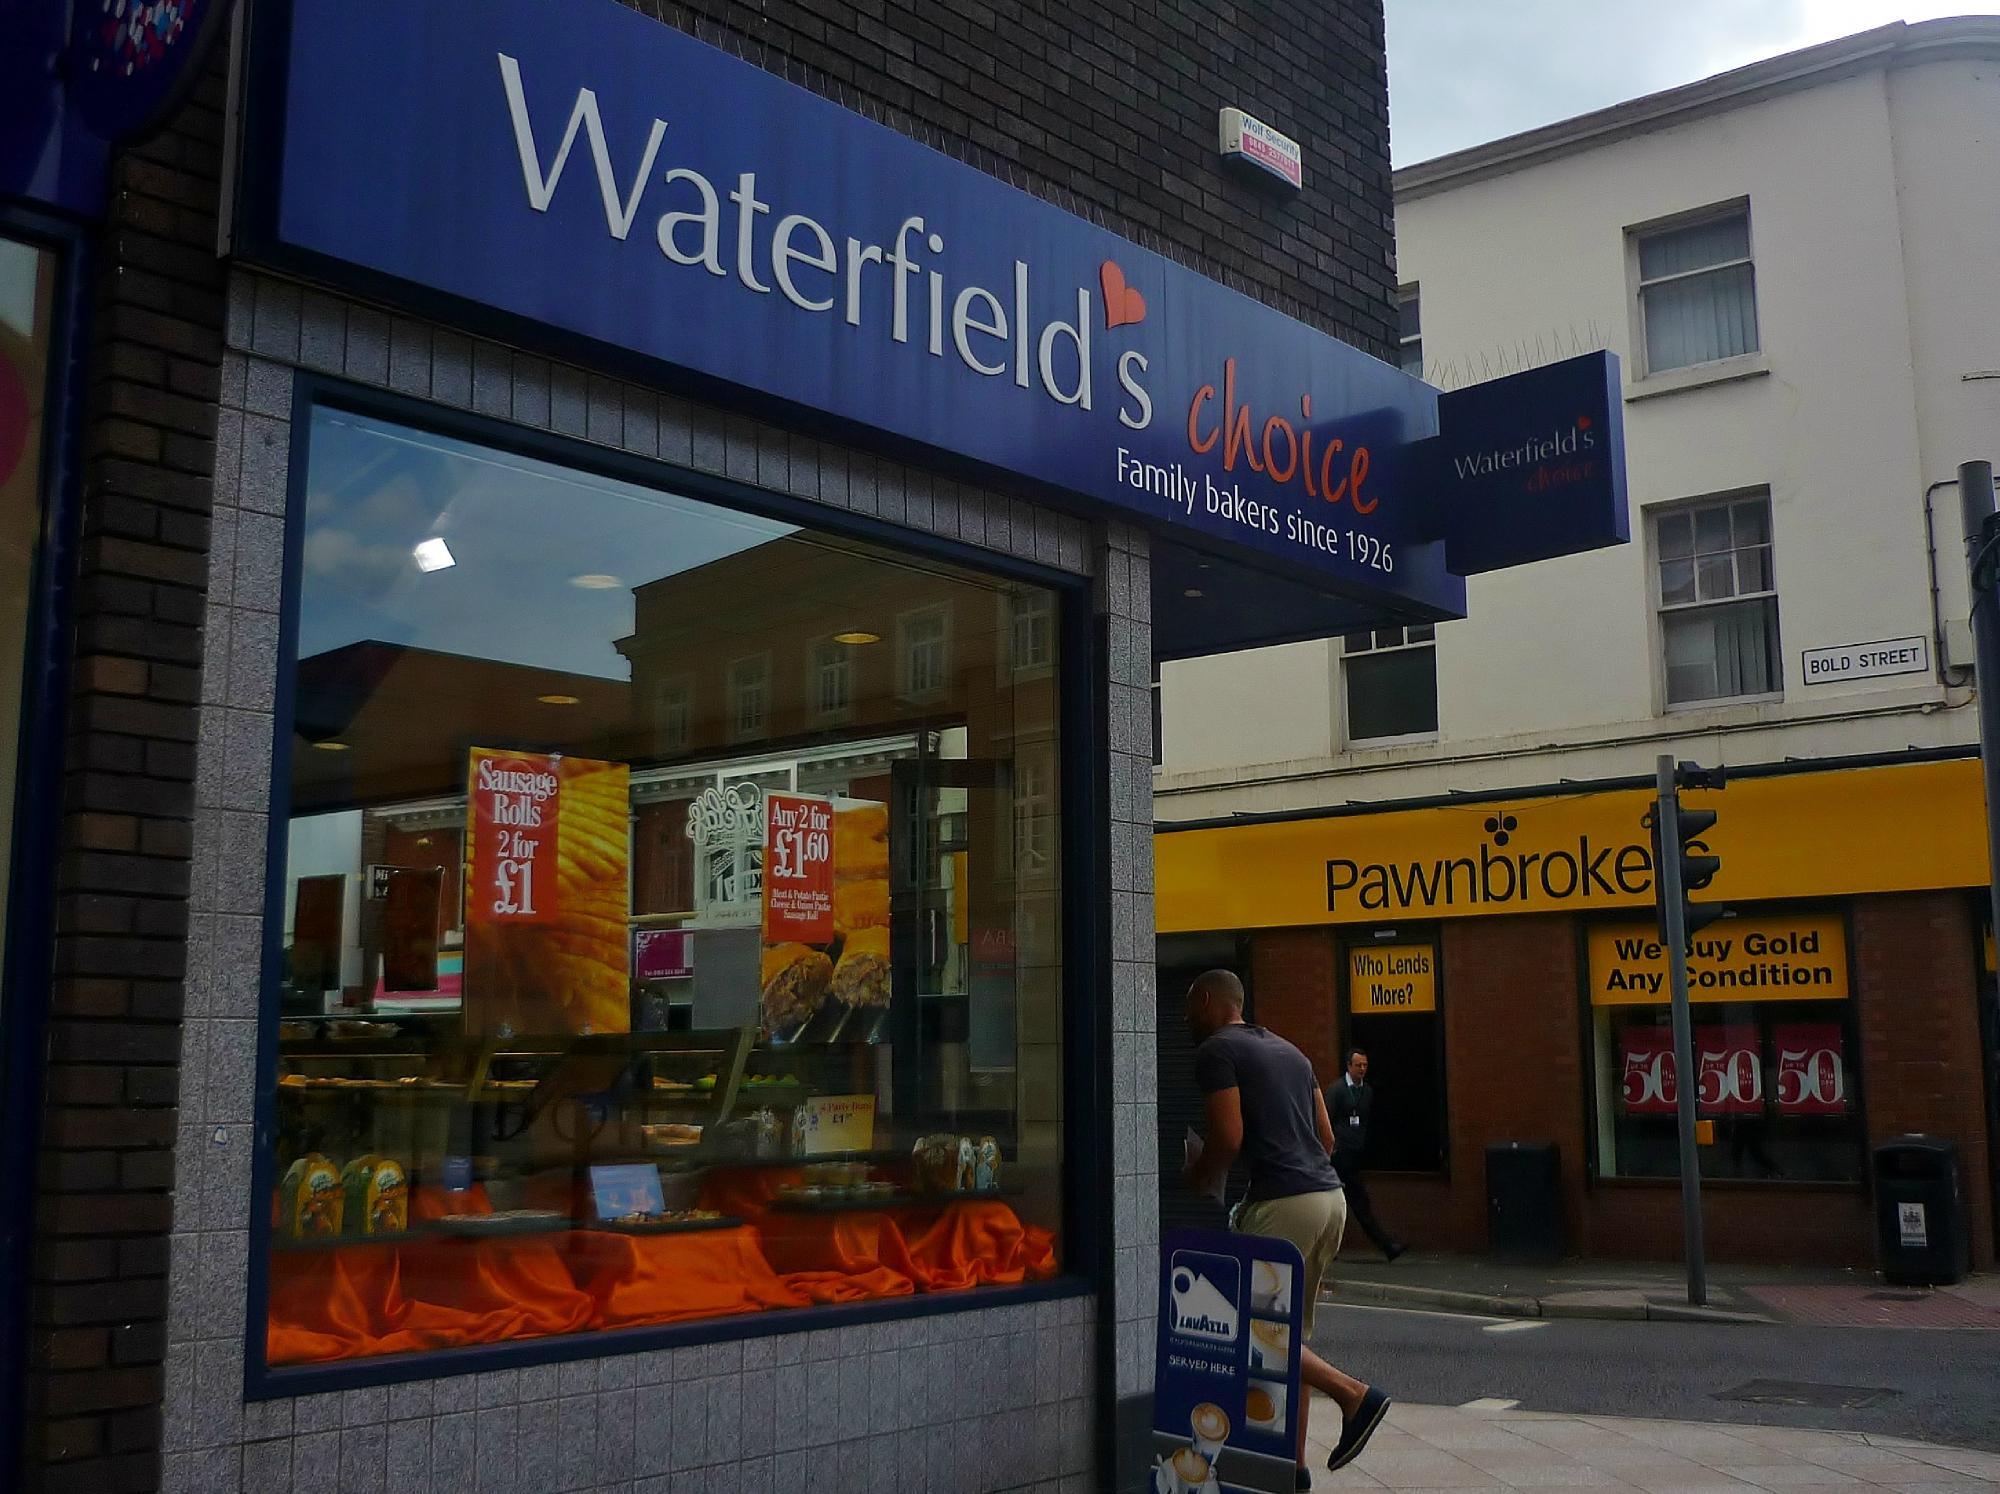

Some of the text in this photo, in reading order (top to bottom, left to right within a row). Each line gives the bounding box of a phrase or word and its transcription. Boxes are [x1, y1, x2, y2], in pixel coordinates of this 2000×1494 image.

[1187, 356, 1378, 515] choice
[1117, 447, 1393, 573] Family bakers since 1926
[1810, 647, 1919, 674] BOLD STREET
[479, 759, 558, 801] Sausage
[492, 793, 542, 827] Rolls
[770, 800, 831, 833] Any 2 for
[497, 829, 539, 859] 2 for
[773, 829, 830, 879] £1.60
[494, 860, 537, 915] £1
[1327, 835, 1713, 912] Pawnbrokes
[1615, 939, 1662, 960] We
[1743, 931, 1819, 956] Gold
[1353, 951, 1429, 976] Who Lends
[1370, 982, 1413, 1006] More?
[1606, 968, 1664, 994] Any
[1698, 1050, 1762, 1104] 50
[1778, 1049, 1844, 1104] 50
[1179, 1314, 1230, 1335] LAVAZZA
[1169, 1353, 1237, 1376] SERVED HERE
